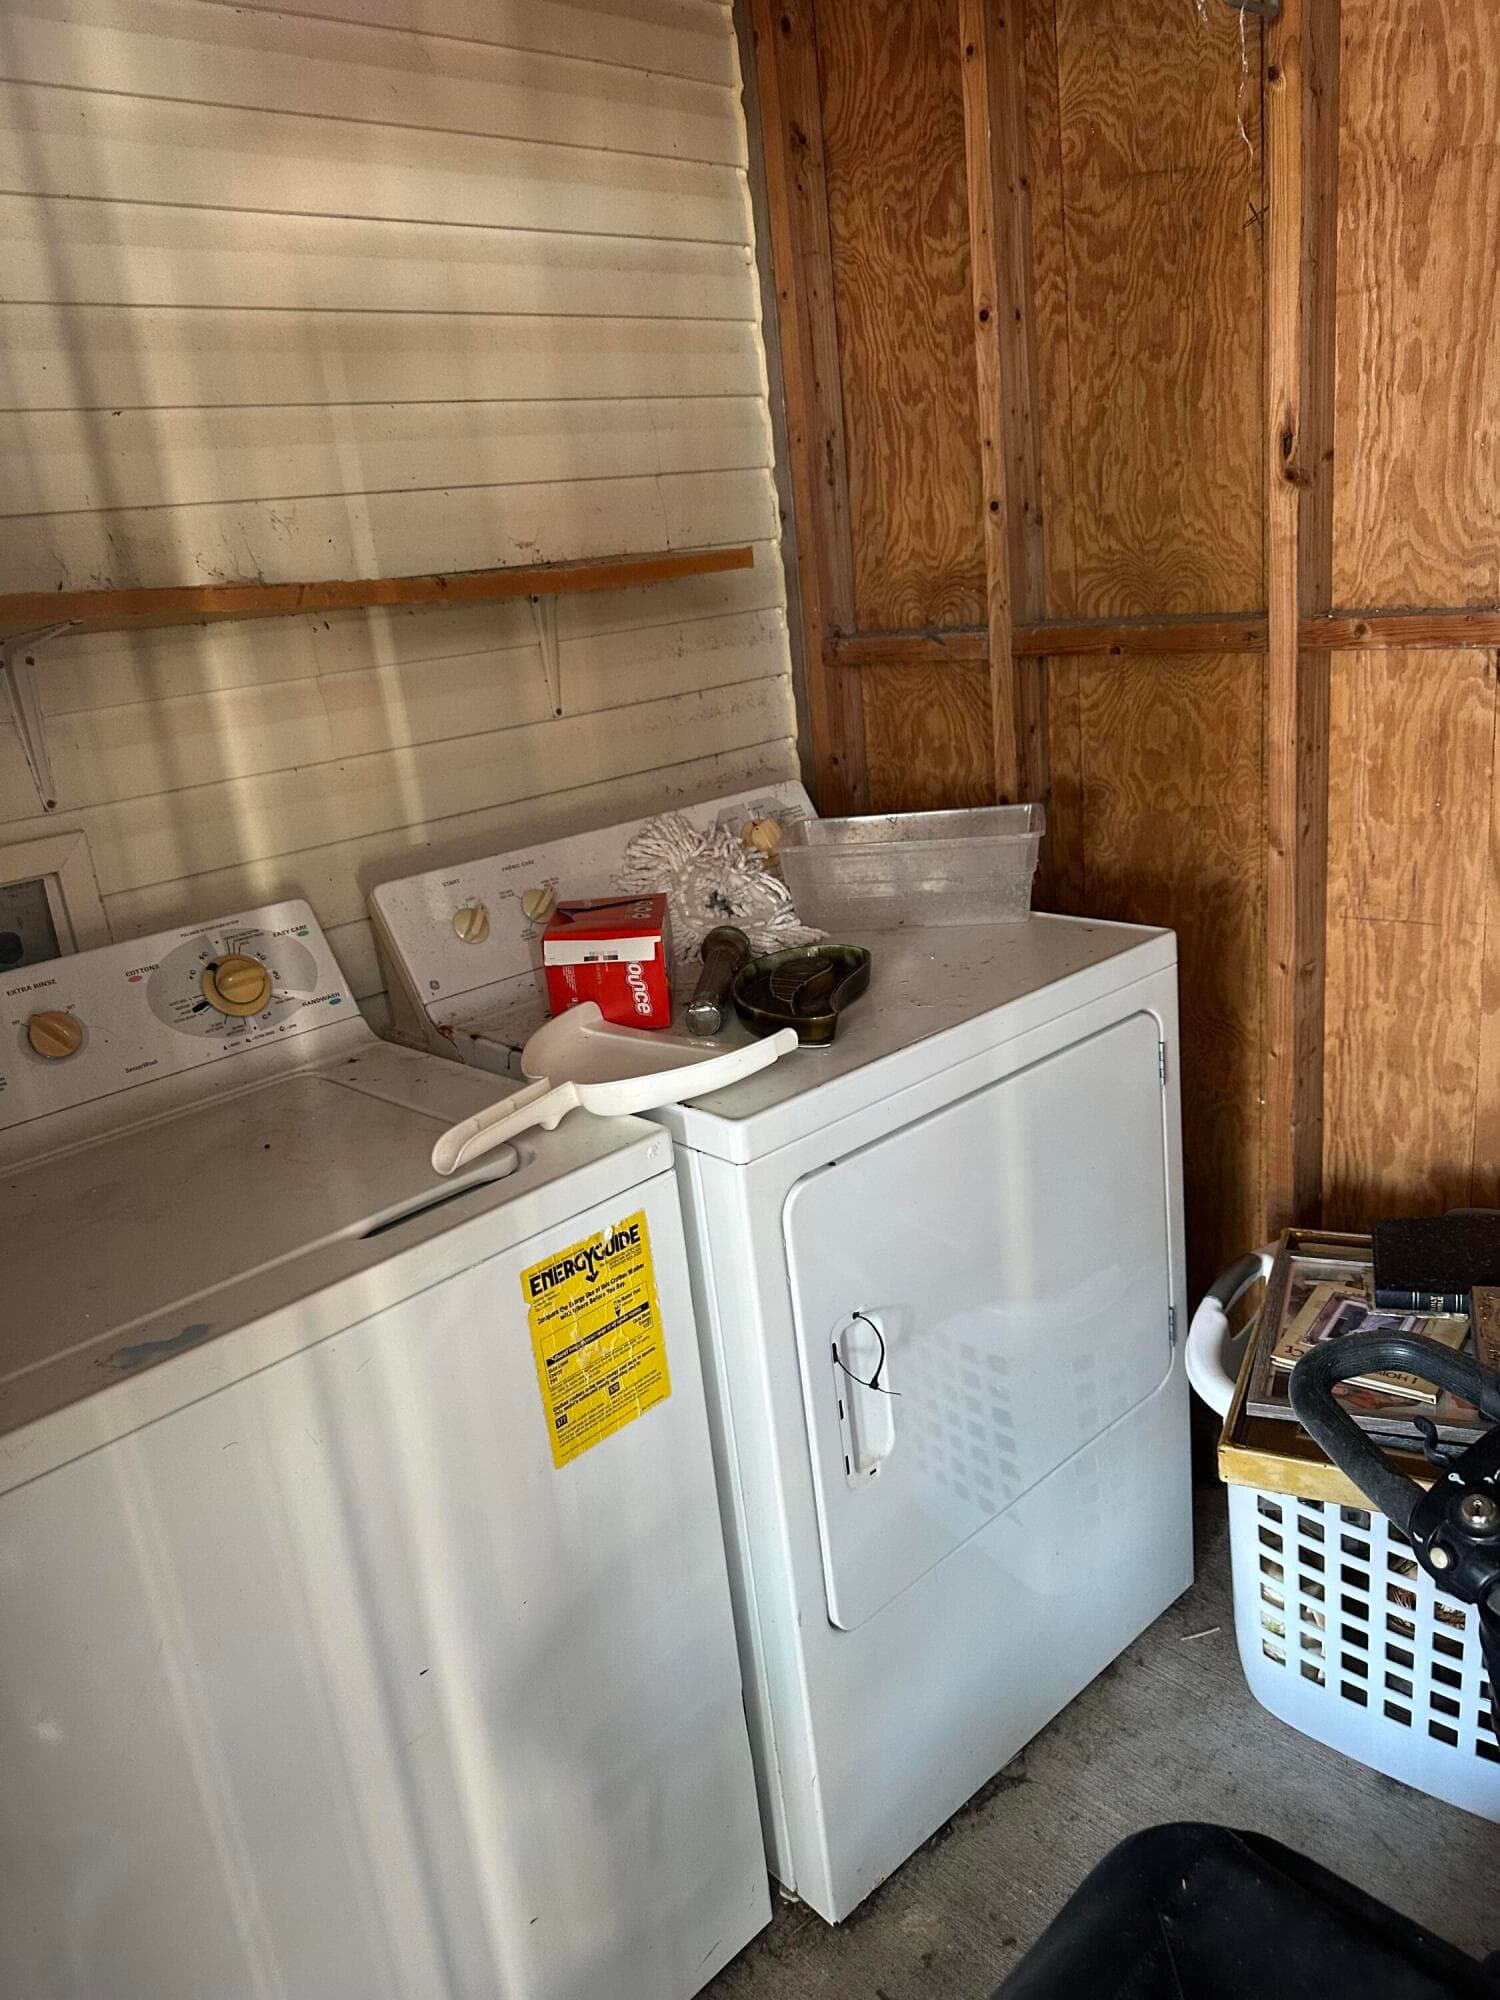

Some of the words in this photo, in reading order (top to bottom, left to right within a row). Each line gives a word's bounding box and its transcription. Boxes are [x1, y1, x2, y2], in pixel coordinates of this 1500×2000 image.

[272, 928, 290, 938] EASY
[291, 924, 308, 934] CARE
[125, 963, 160, 977] COTTONS
[6, 986, 32, 997] EXTRA
[32, 978, 57, 991] RINSE
[626, 960, 653, 1017] ounce
[301, 991, 341, 1008] HANDWASH
[125, 1058, 159, 1074] SensorWash
